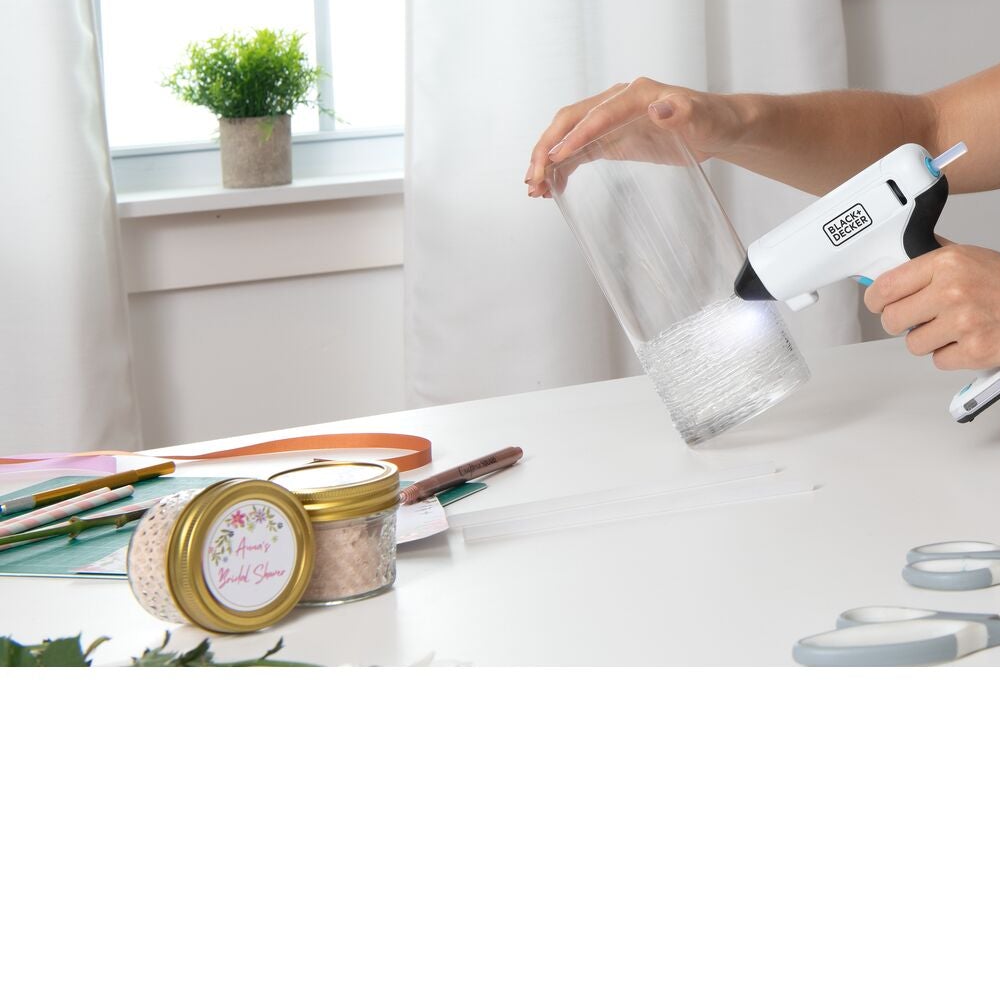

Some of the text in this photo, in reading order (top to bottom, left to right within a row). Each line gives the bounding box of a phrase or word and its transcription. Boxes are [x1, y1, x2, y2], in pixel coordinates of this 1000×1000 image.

[828, 210, 861, 235] BLACK+
[833, 216, 868, 241] DECKER
[236, 537, 270, 559] Anna's
[218, 562, 286, 589] Bridal Shower
